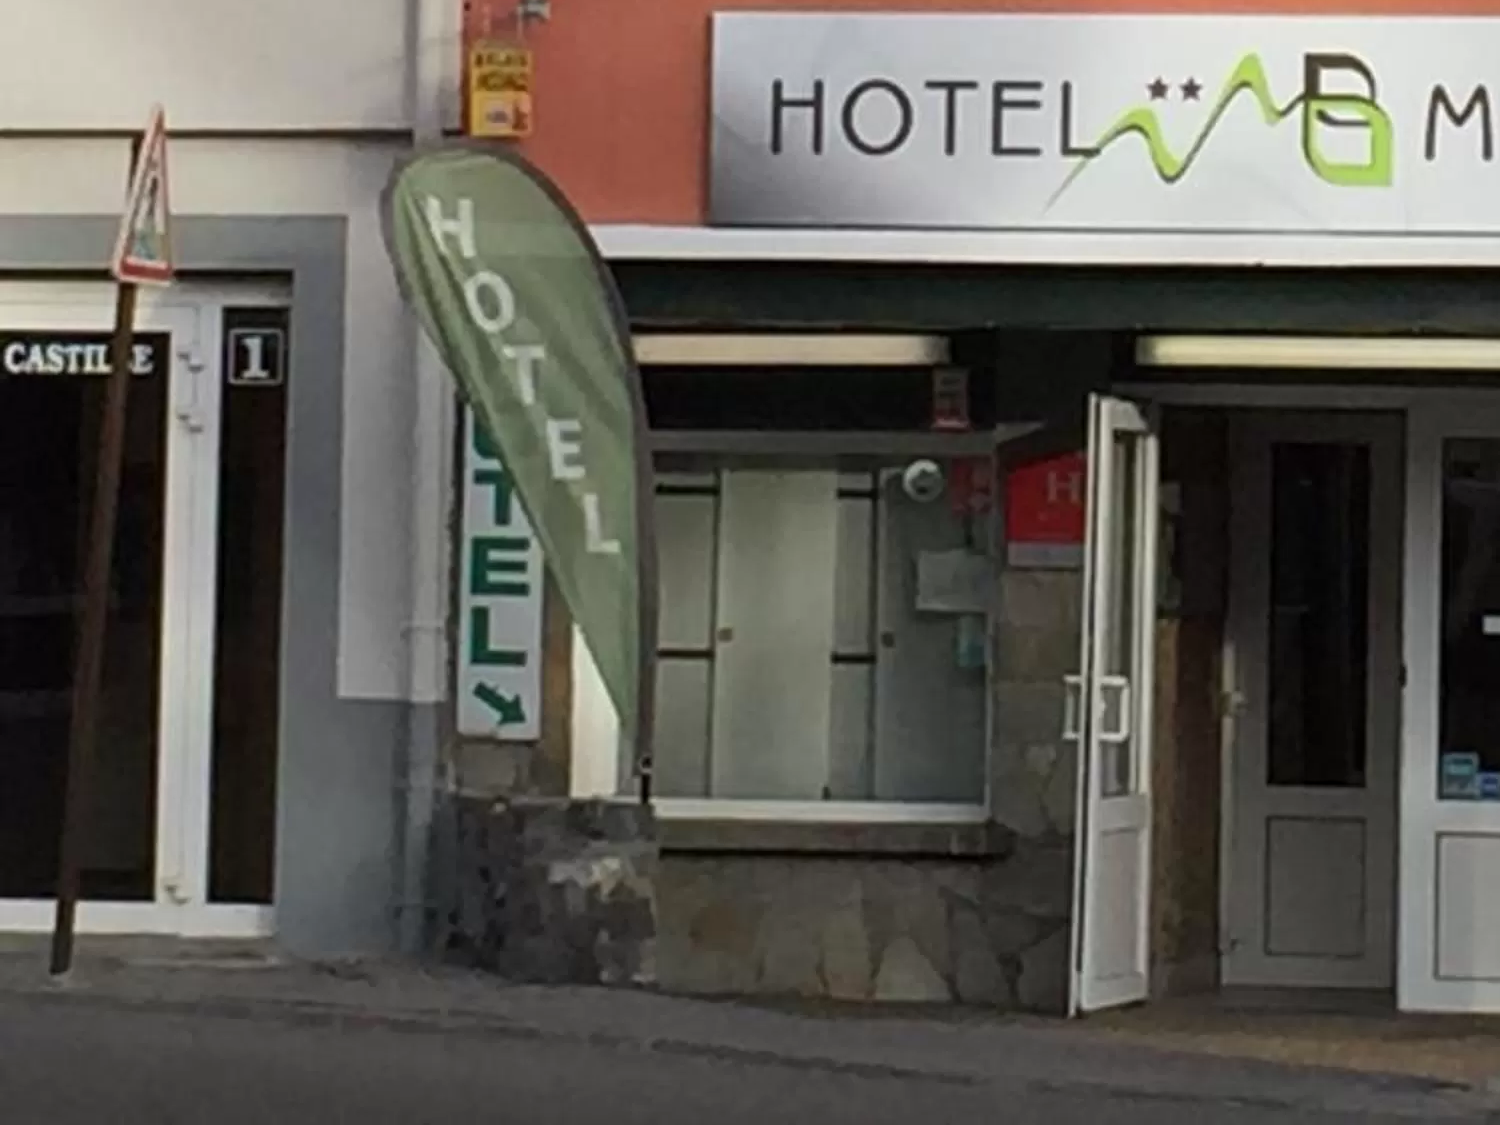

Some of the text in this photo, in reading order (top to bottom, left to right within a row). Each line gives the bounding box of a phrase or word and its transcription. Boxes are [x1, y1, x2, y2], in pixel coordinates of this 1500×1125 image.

[770, 78, 1101, 158] HOTEL
[3, 340, 154, 375] CASTILE
[240, 335, 270, 379] 1
[425, 196, 621, 555] HOTEL
[469, 405, 533, 667] TEL
